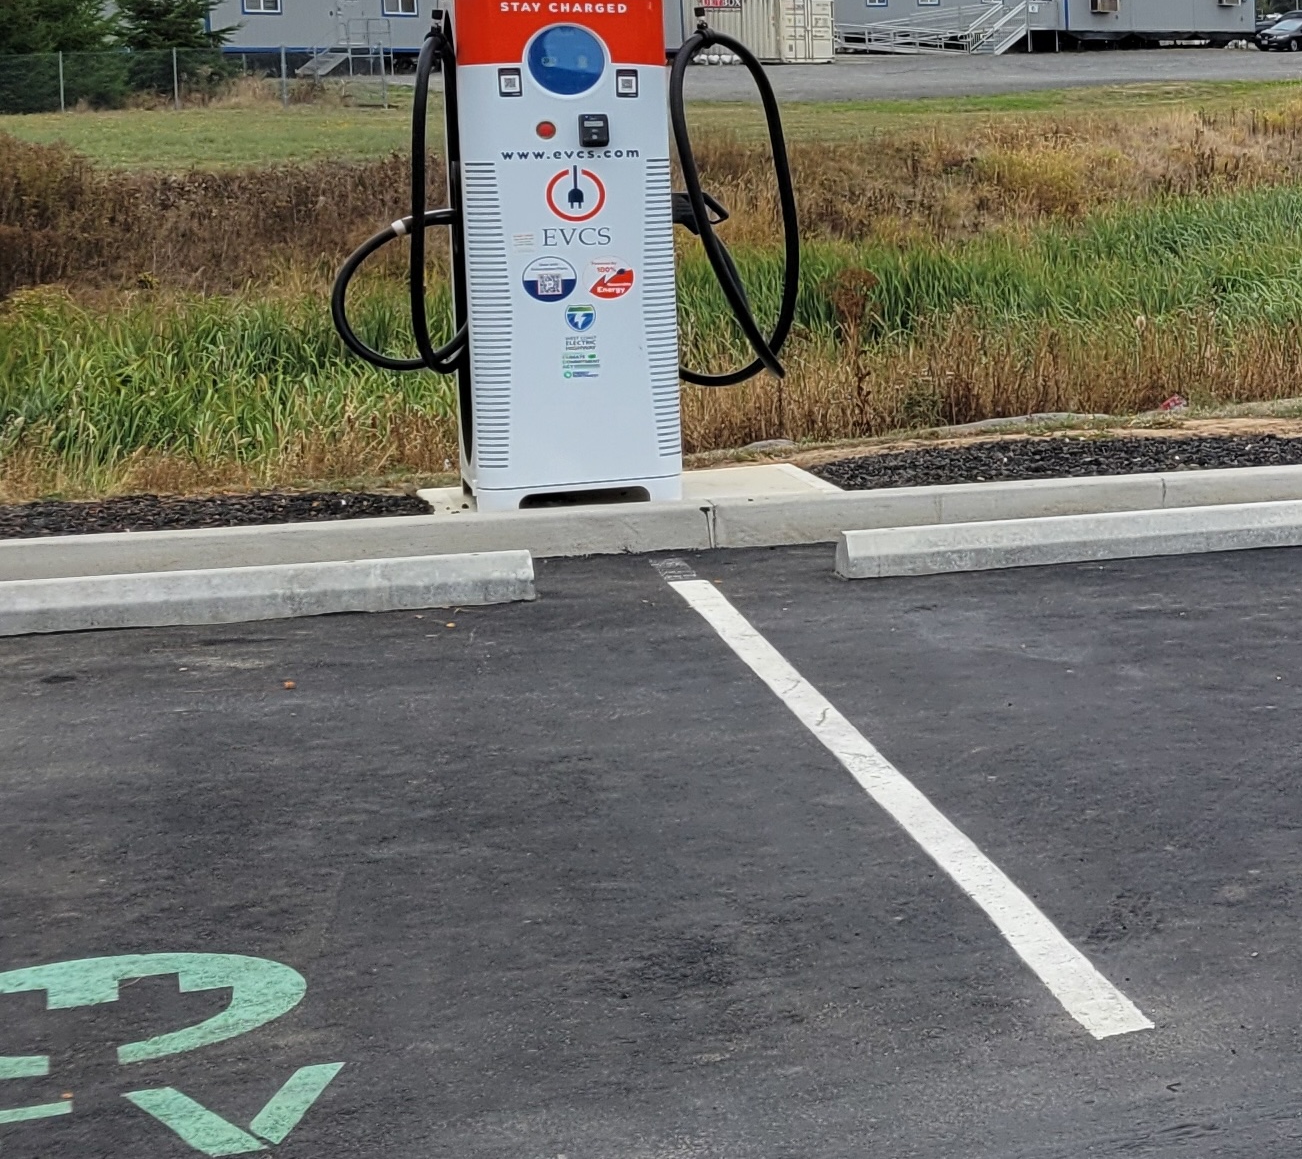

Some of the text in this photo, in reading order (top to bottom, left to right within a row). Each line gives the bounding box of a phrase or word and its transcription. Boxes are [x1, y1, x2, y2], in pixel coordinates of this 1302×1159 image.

[501, 1, 628, 13] STAY CHARGED
[501, 149, 640, 160] www.evcs.com
[542, 227, 612, 247] EVCS
[597, 286, 626, 294] Energy
